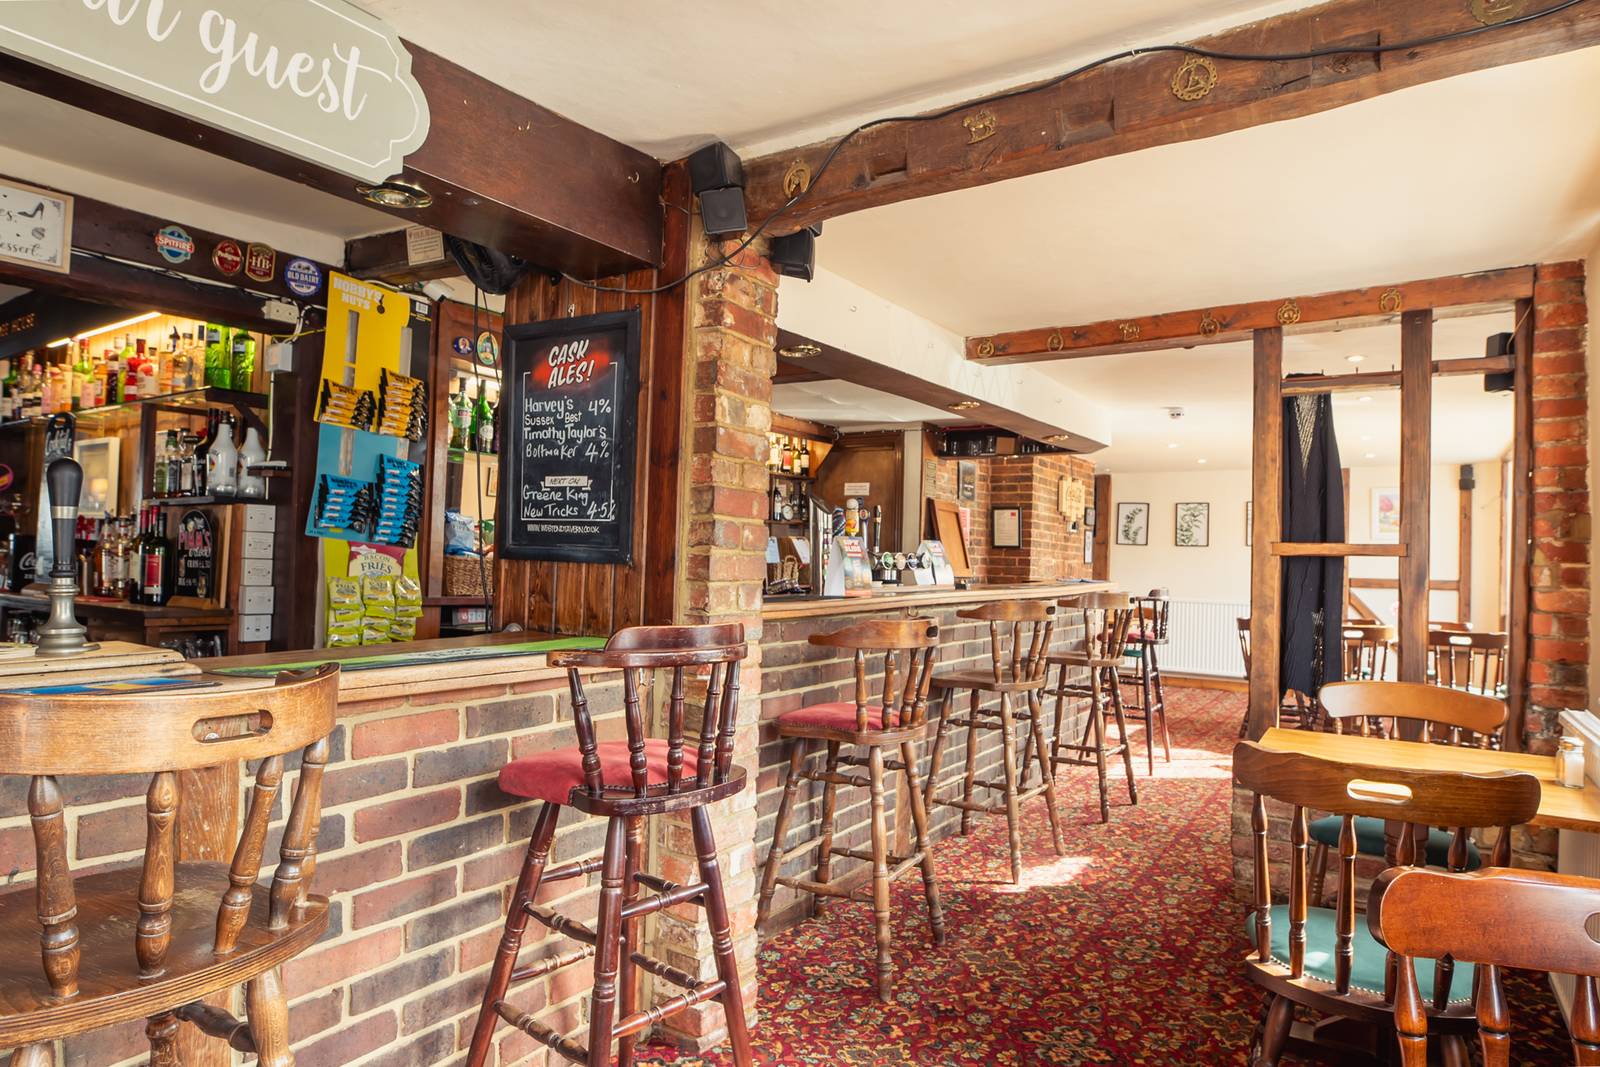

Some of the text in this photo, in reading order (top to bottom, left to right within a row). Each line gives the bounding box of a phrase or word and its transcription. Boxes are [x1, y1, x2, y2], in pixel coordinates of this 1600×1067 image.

[199, 10, 392, 121] guest
[158, 237, 192, 250] SPITFIRE
[548, 339, 590, 367] CASK
[547, 360, 595, 389] ALES!
[524, 395, 612, 419] Harvey's 4%
[524, 411, 582, 426] Sussex Best
[523, 423, 607, 445] Timothy Taylor's
[585, 440, 610, 462] 4%
[523, 484, 589, 506] Greene King
[523, 502, 544, 518] New
[544, 502, 579, 517] Tricks
[361, 562, 393, 574] FRIES
[363, 553, 391, 563] BACON
